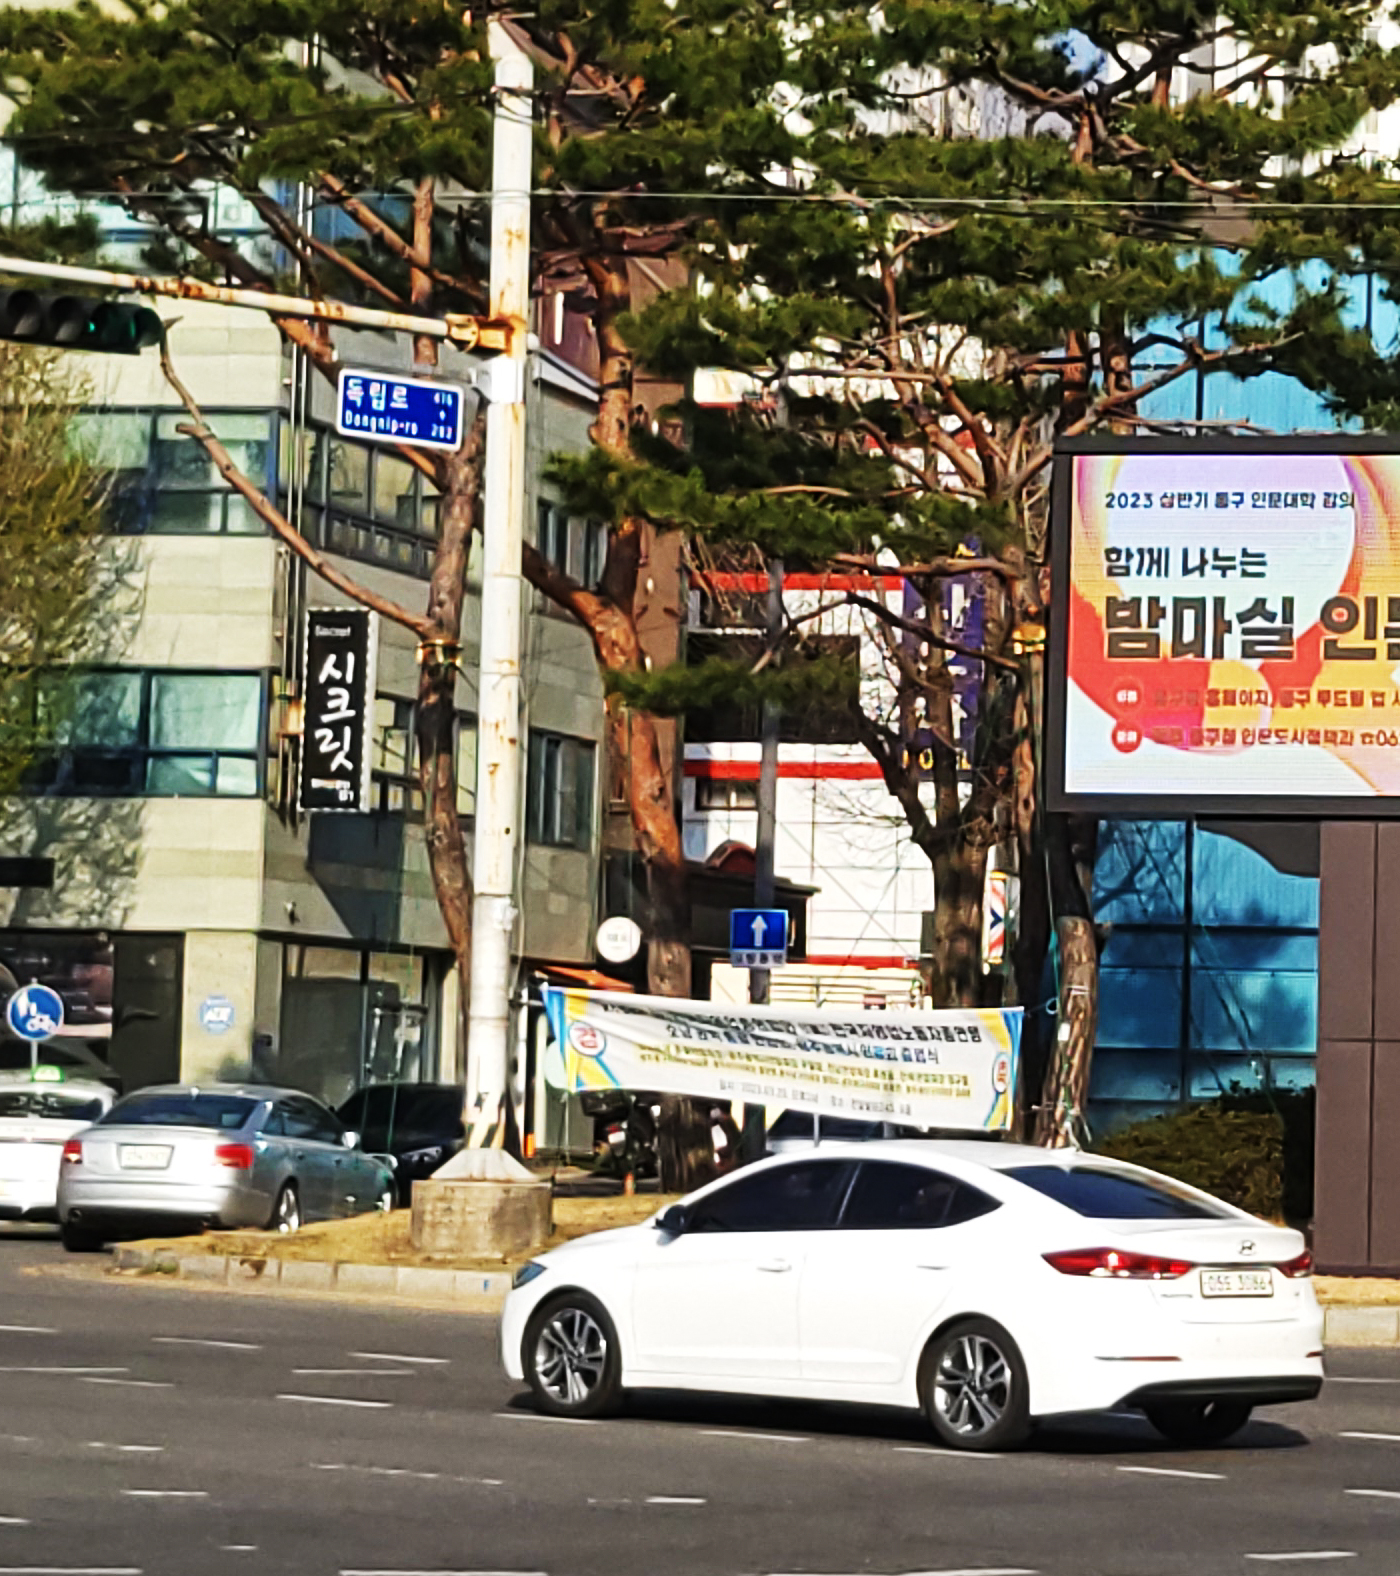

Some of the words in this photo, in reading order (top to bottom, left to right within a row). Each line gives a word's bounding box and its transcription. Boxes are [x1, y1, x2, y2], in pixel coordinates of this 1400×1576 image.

[346, 378, 408, 412] 독립로
[1105, 492, 1154, 509] 2023
[1159, 492, 1209, 510] 상반기
[1214, 492, 1245, 510] 동구
[1251, 492, 1316, 510] 인문대학
[1104, 547, 1170, 578] 함께
[1182, 547, 1267, 578] 나누는
[1105, 596, 1295, 660] 밤마실
[314, 651, 356, 772] 시크릿
